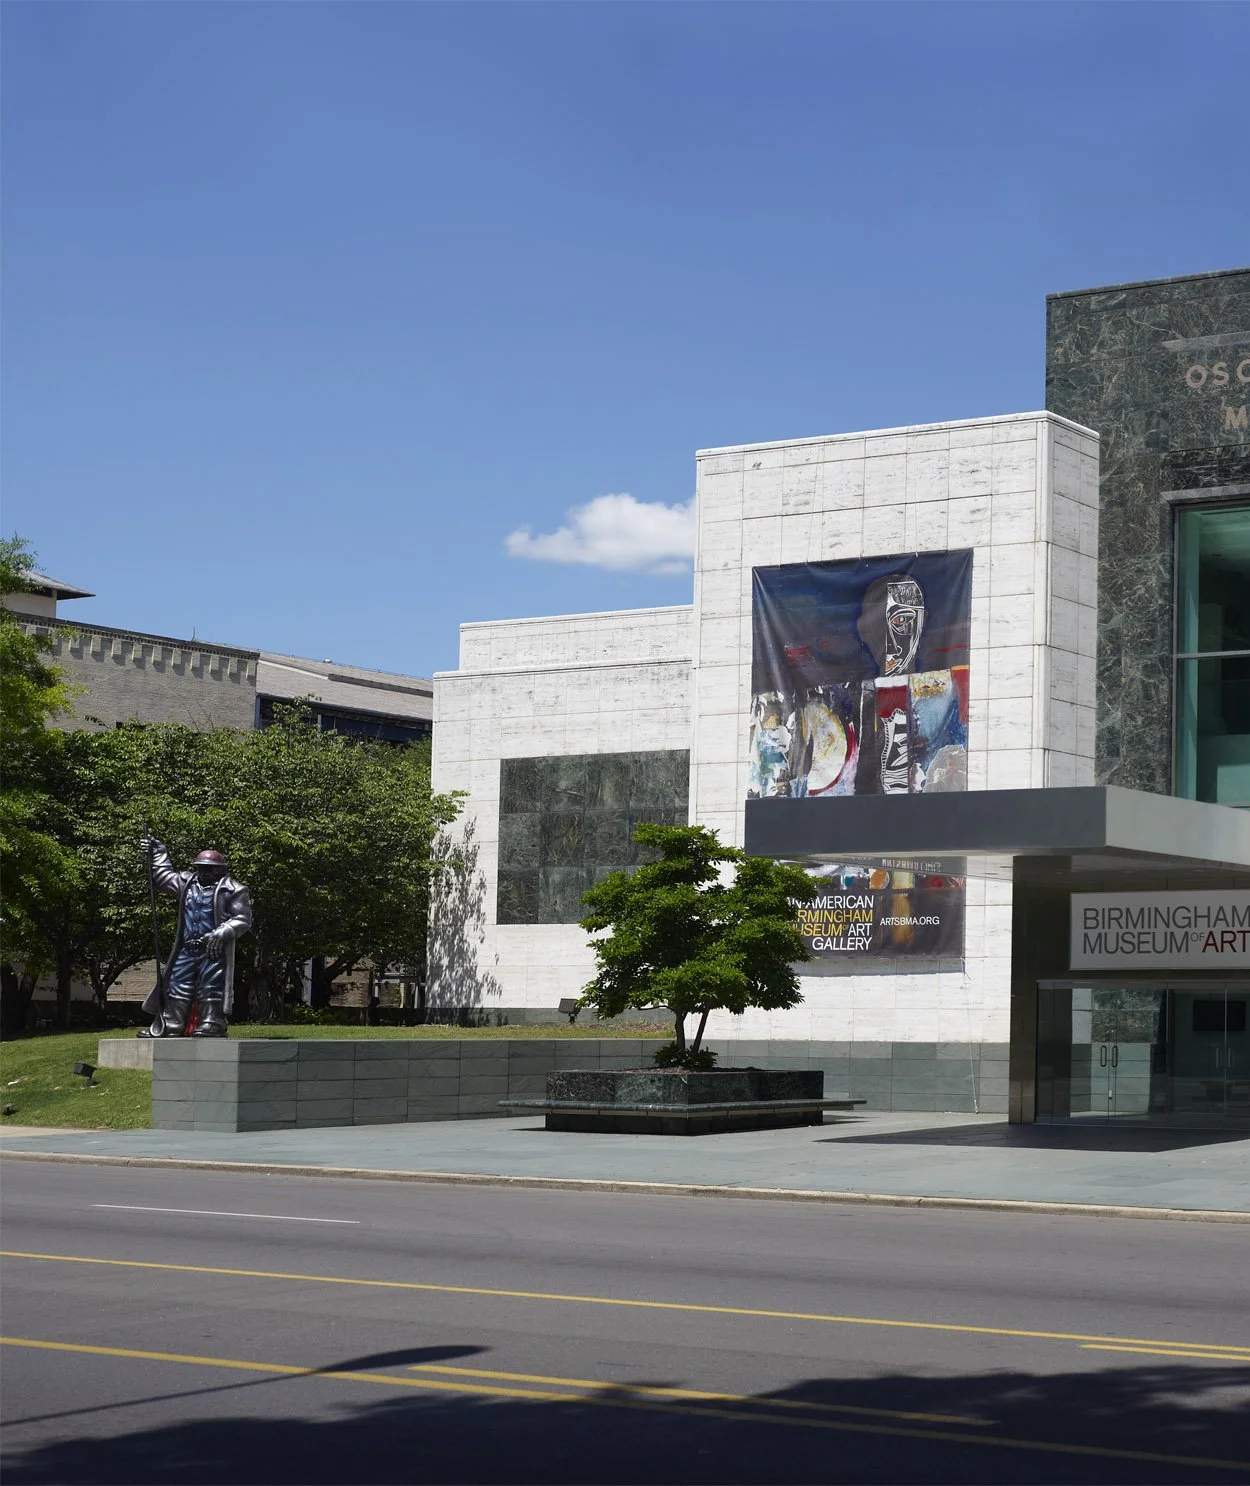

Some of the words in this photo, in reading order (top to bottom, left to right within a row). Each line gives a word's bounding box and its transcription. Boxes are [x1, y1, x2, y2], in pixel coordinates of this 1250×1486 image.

[796, 909, 873, 923] RMINGHAM
[879, 916, 940, 926] ARTSBMA.ORG
[792, 923, 843, 937] USEUM
[848, 923, 873, 937] ART
[812, 937, 873, 951] GALLERY
[1083, 931, 1189, 954] MUSEUM
[1190, 932, 1205, 942] OF
